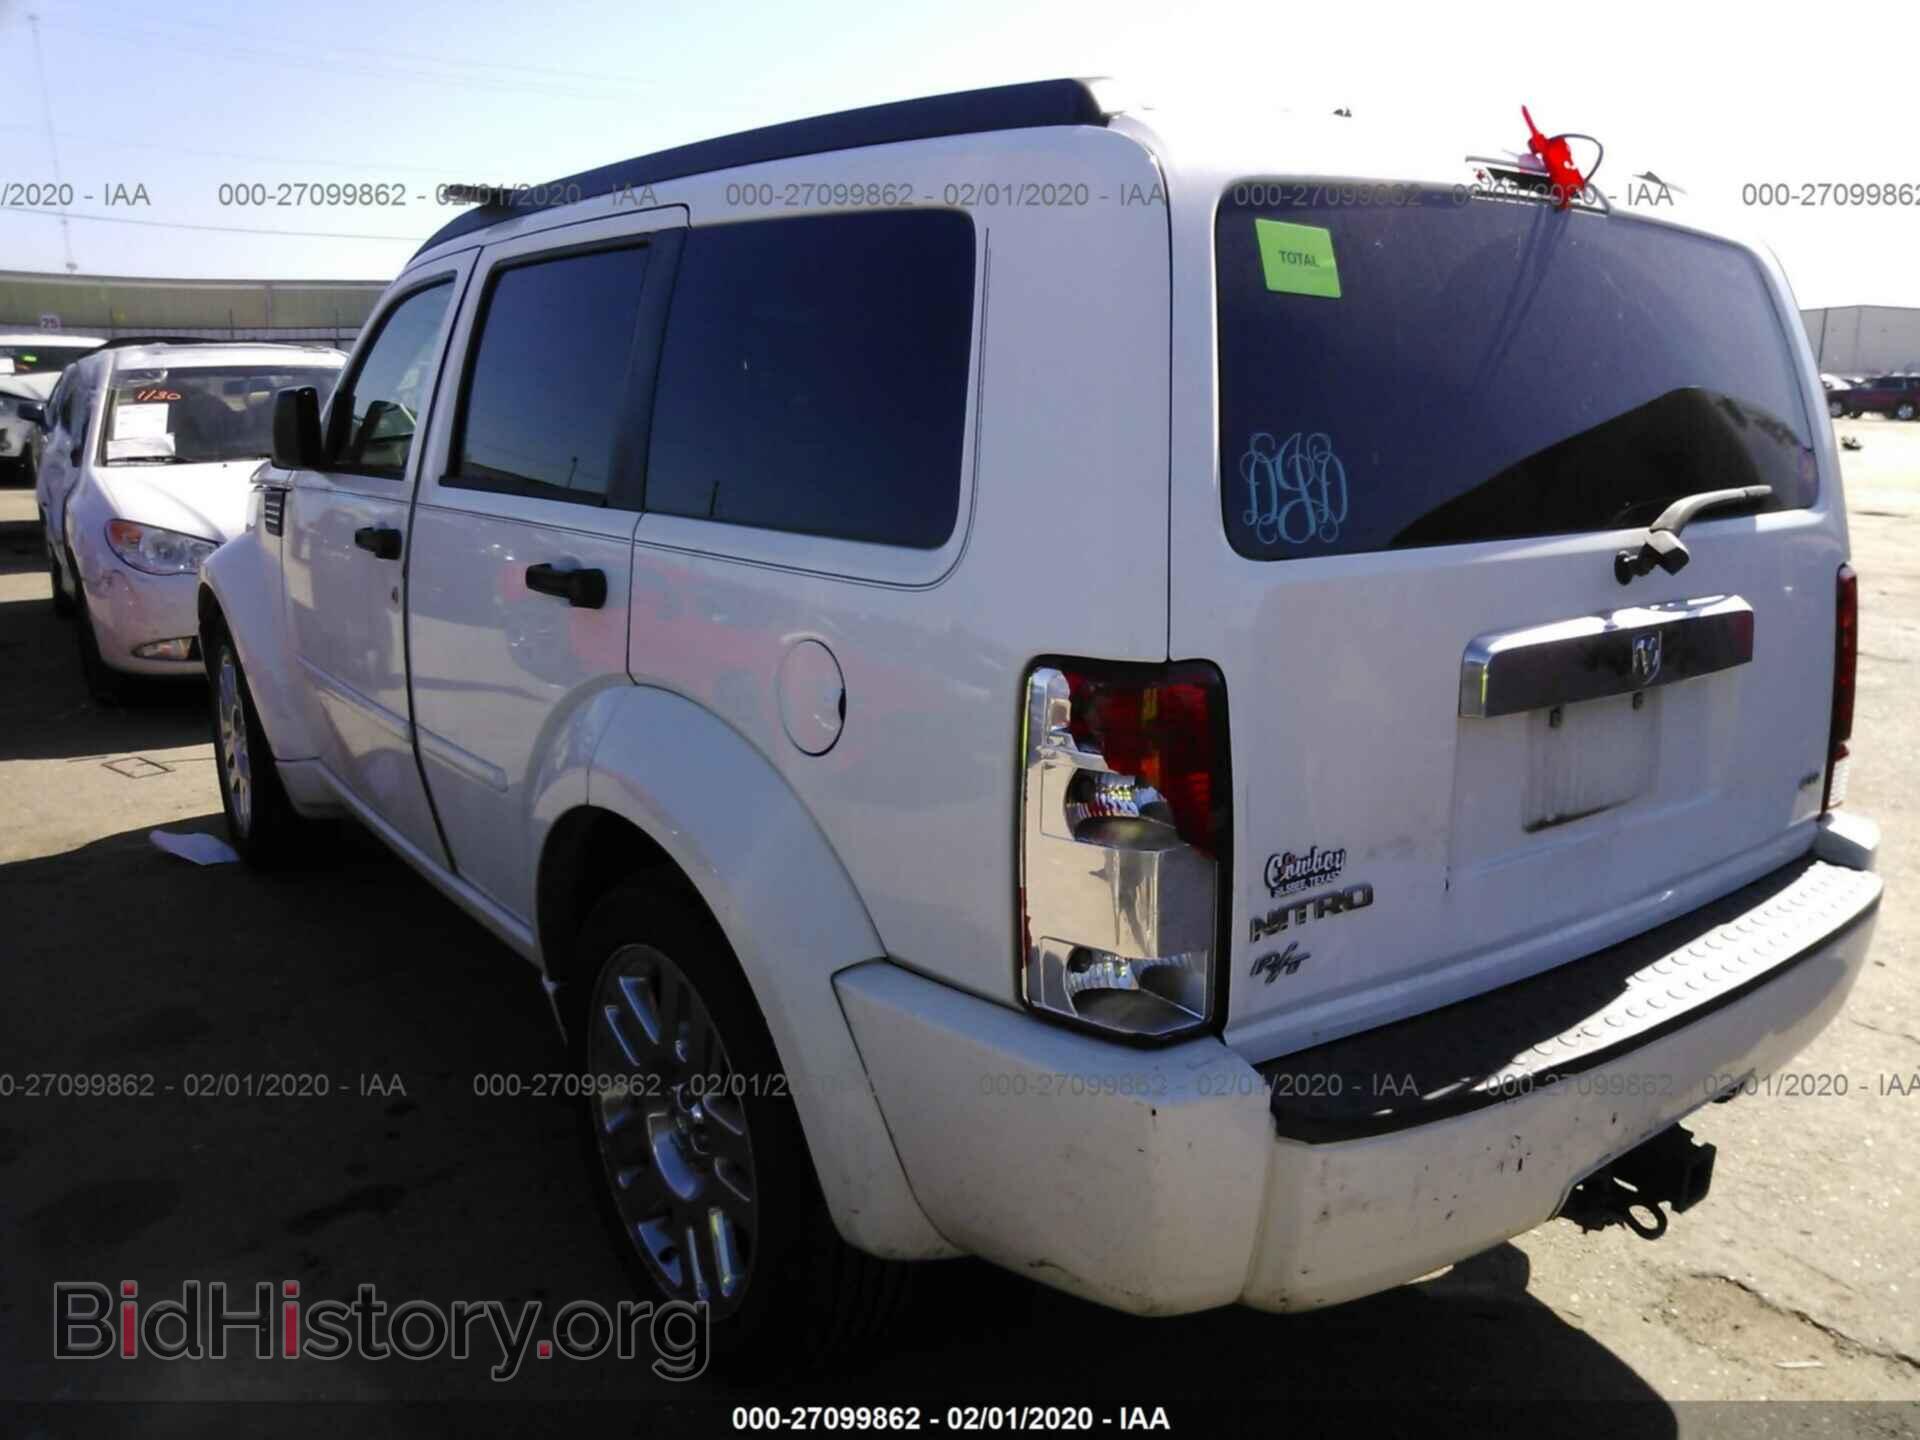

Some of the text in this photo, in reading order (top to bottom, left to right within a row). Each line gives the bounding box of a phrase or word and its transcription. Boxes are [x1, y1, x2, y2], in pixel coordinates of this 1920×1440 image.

[1278, 250, 1321, 268] TOTAL
[1249, 882, 1374, 944] NITRO
[1249, 941, 1312, 985] R/T
